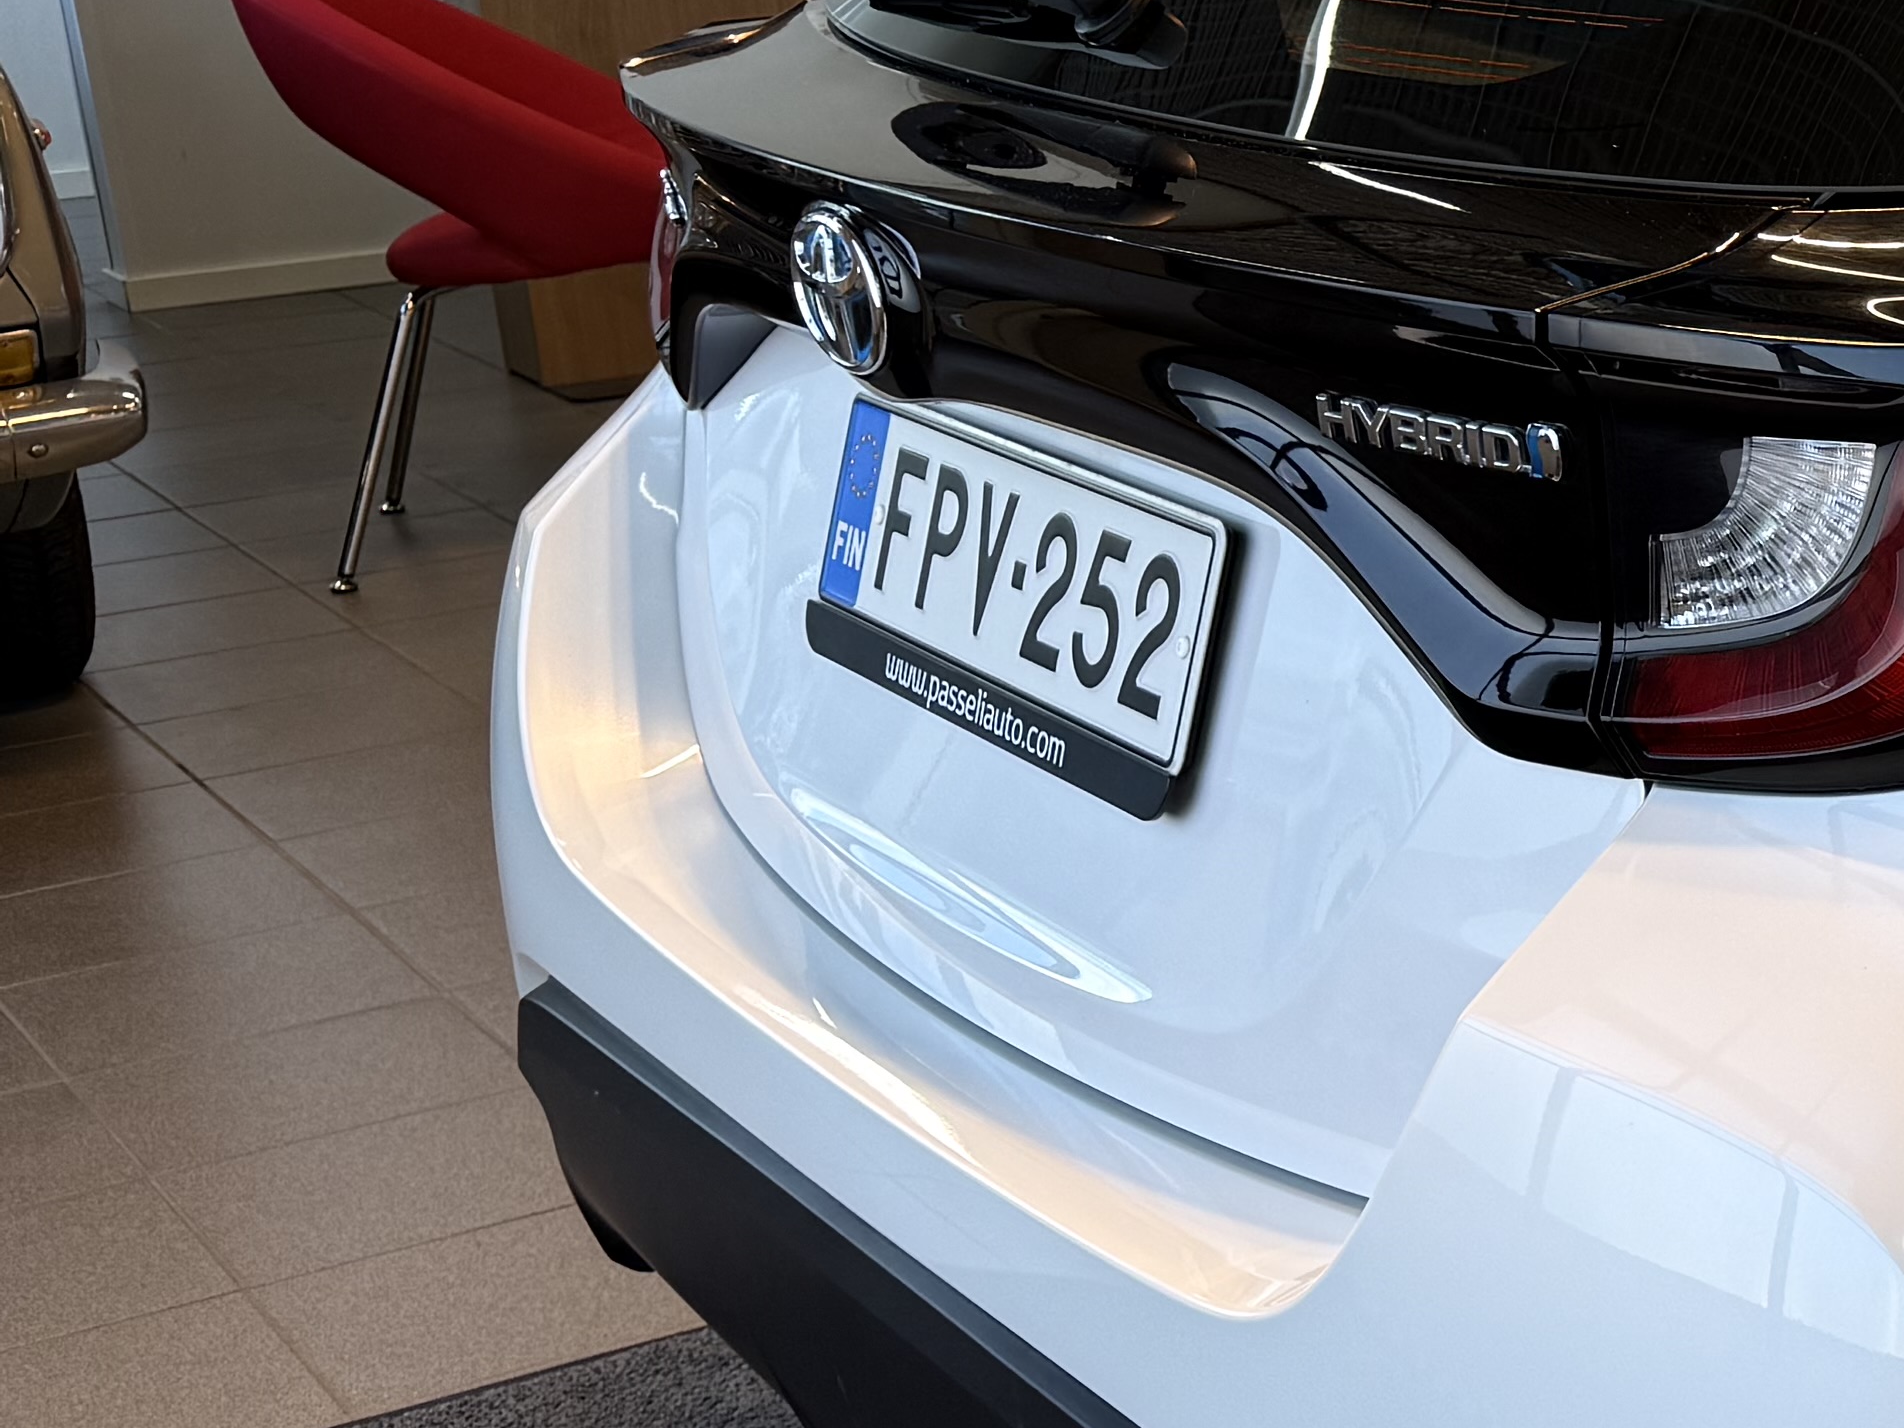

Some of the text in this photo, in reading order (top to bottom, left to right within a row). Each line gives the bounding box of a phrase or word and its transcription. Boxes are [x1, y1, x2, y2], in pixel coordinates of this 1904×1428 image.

[1316, 392, 1523, 473] HYBRID
[832, 520, 866, 571] FIN
[874, 446, 1181, 721] FPV-252
[885, 652, 1066, 768] www.passeliauto.com
